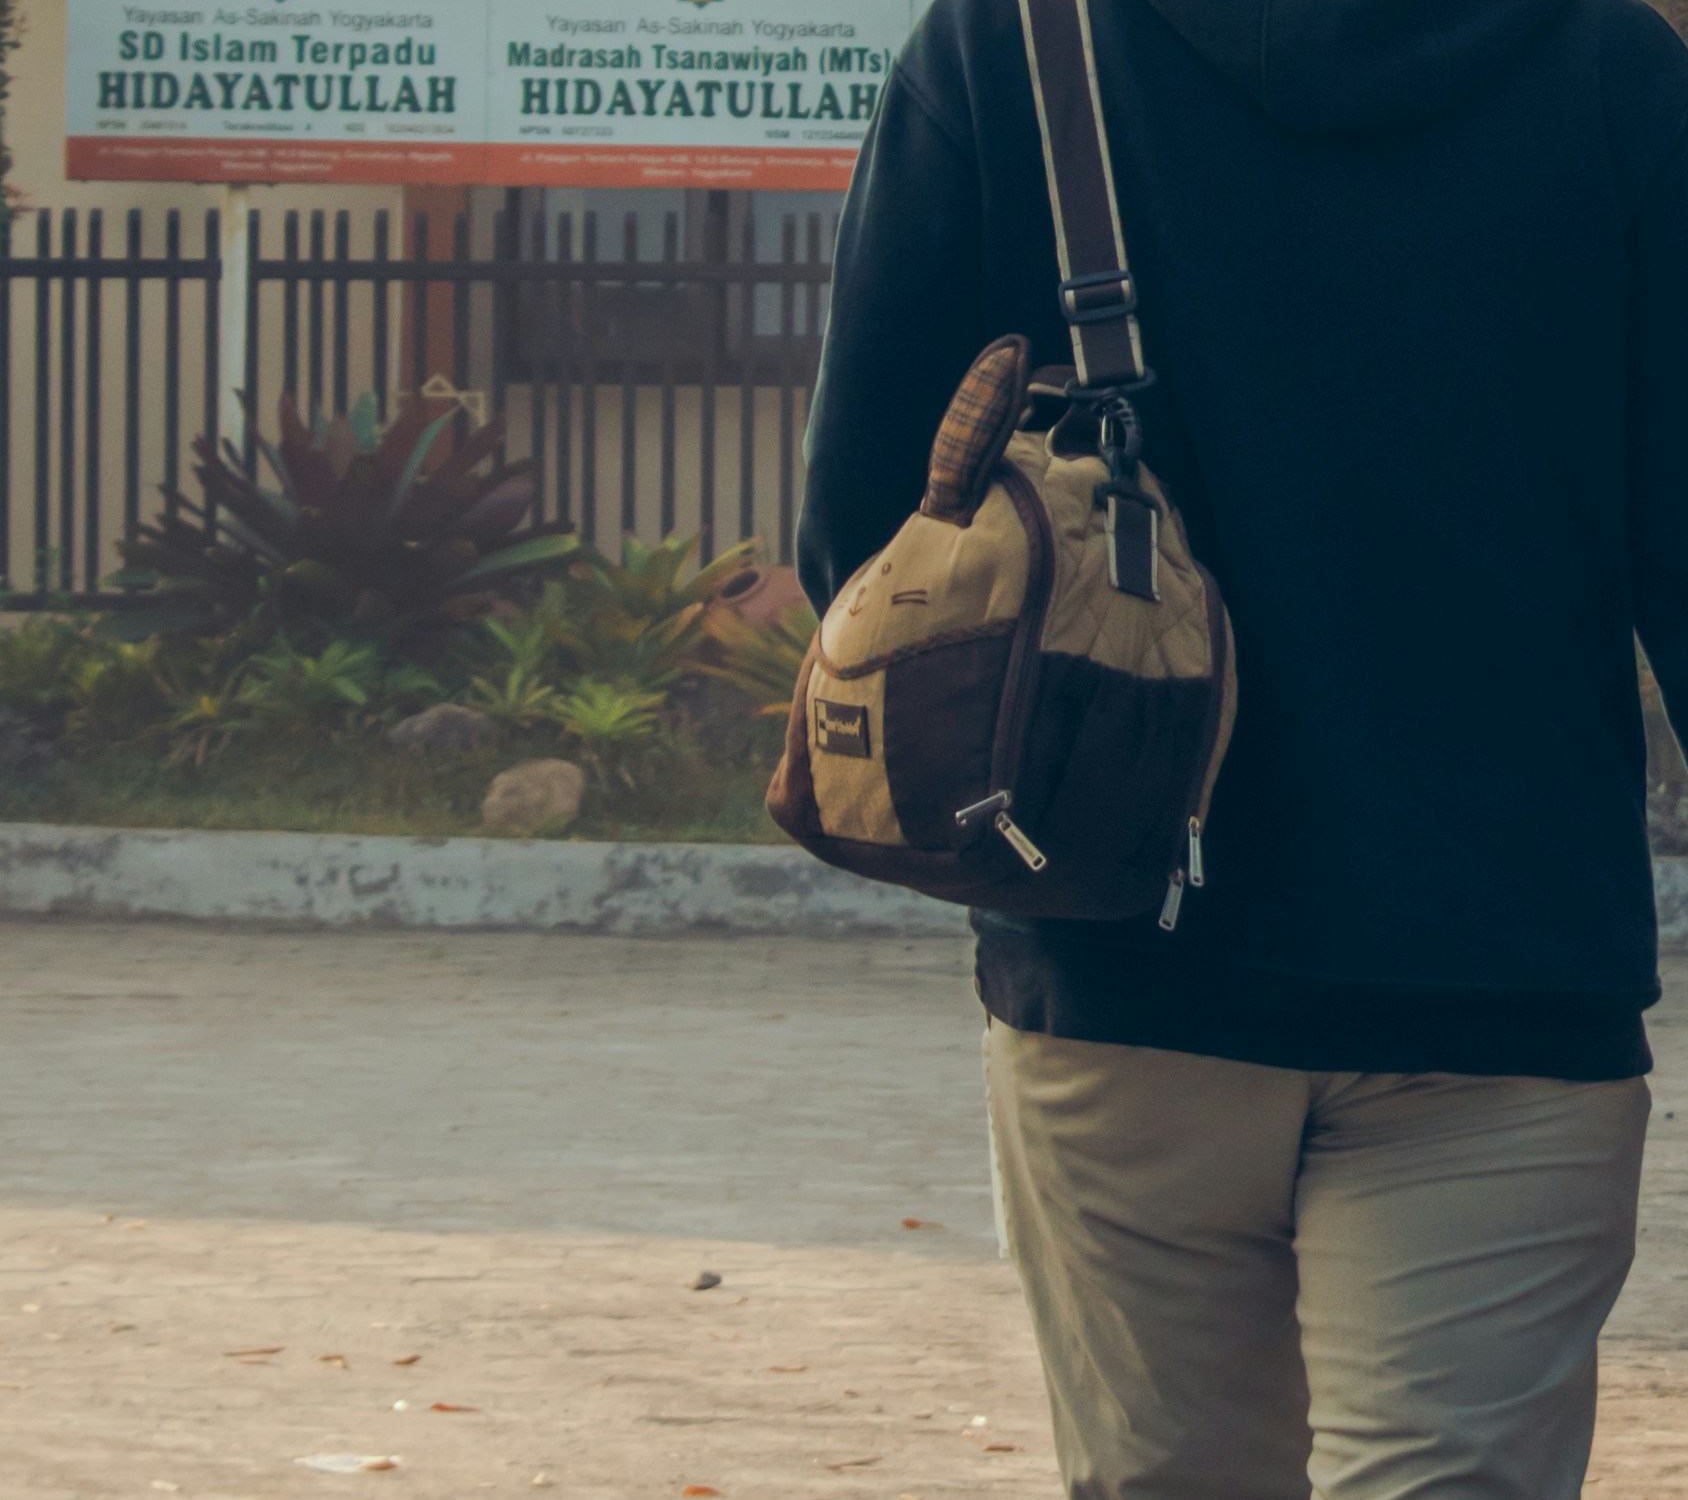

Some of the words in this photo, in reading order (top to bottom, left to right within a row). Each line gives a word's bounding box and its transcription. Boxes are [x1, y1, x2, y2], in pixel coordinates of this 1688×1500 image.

[122, 6, 204, 26] Yayasan
[212, 7, 321, 26] As-Sakinah
[329, 9, 434, 31] Yogyakarta
[546, 15, 626, 35] Yayasan
[635, 16, 743, 35] As-Sakinah
[751, 19, 856, 40] Yogyakarta
[119, 29, 165, 61] SD
[179, 31, 277, 62] Islam
[291, 34, 436, 71] Terpadu
[507, 40, 642, 69] Madrasah
[651, 43, 808, 77] Tsanawiyah
[819, 47, 891, 75] (MTs)
[96, 70, 456, 113] HIDAYATULLAH
[520, 77, 878, 120] HIDAYATULLAH
